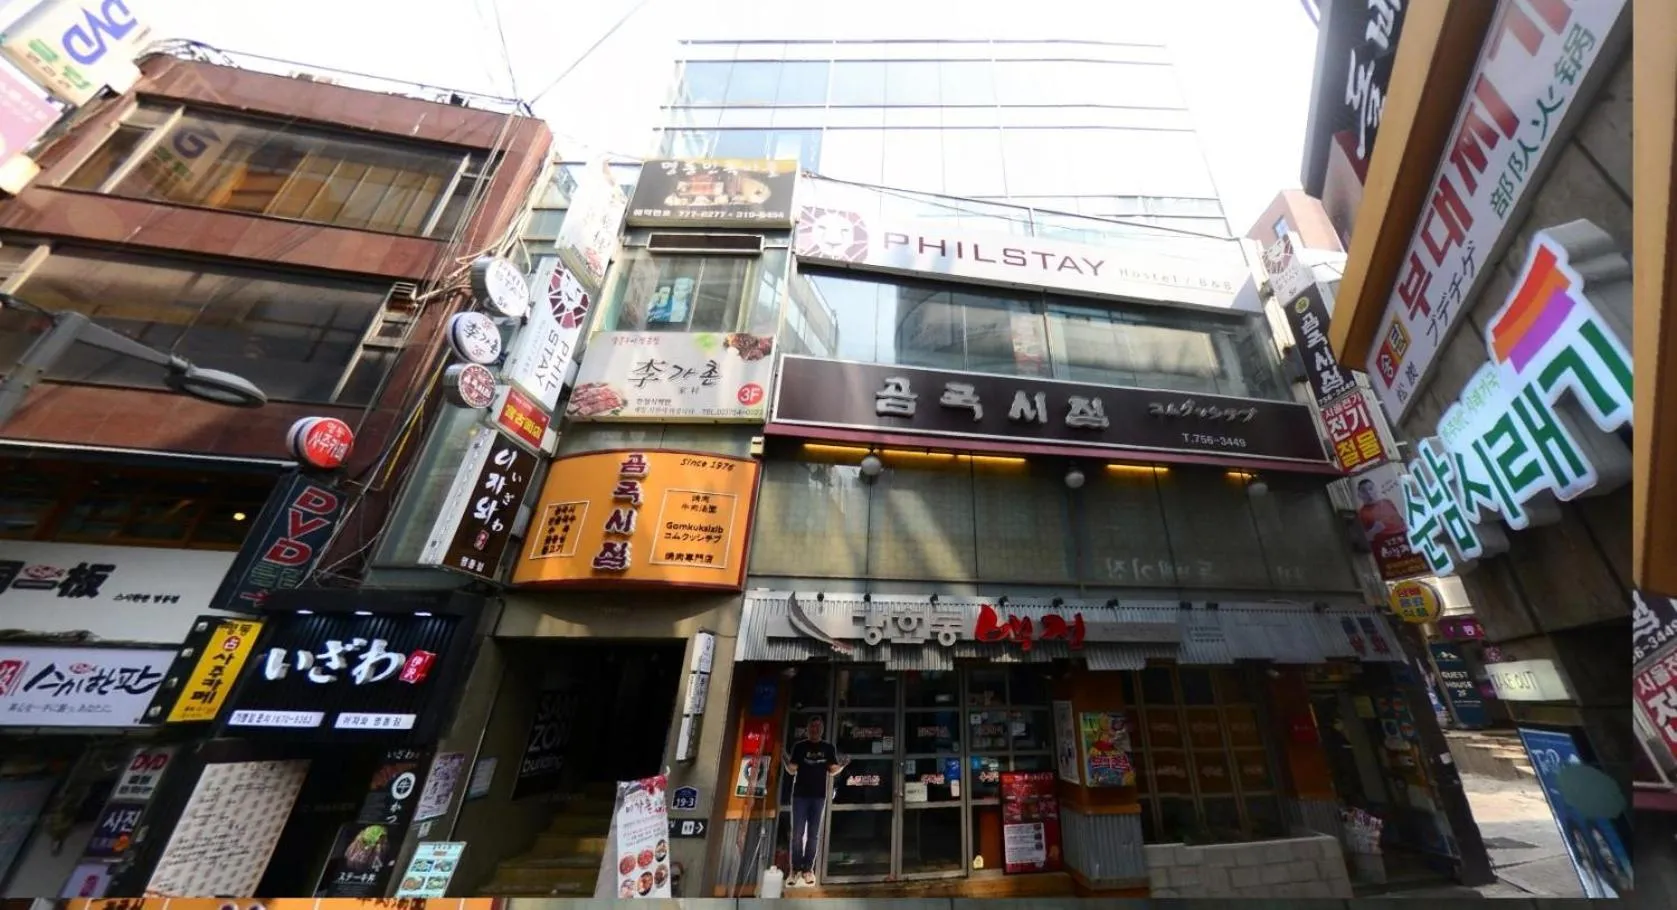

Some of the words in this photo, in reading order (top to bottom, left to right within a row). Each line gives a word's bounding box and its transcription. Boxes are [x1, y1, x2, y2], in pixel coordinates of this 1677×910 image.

[883, 232, 1107, 277] PHILSTAY
[740, 386, 762, 402] 3F
[875, 377, 1111, 431] 곰국시집
[1327, 405, 1371, 443] 전기
[261, 485, 339, 567] DVD
[591, 451, 651, 573] 곰국시집
[262, 637, 408, 685] いざわ
[1633, 617, 1677, 664] 6-3449
[129, 753, 170, 772] DVD
[102, 808, 143, 835] 사진
